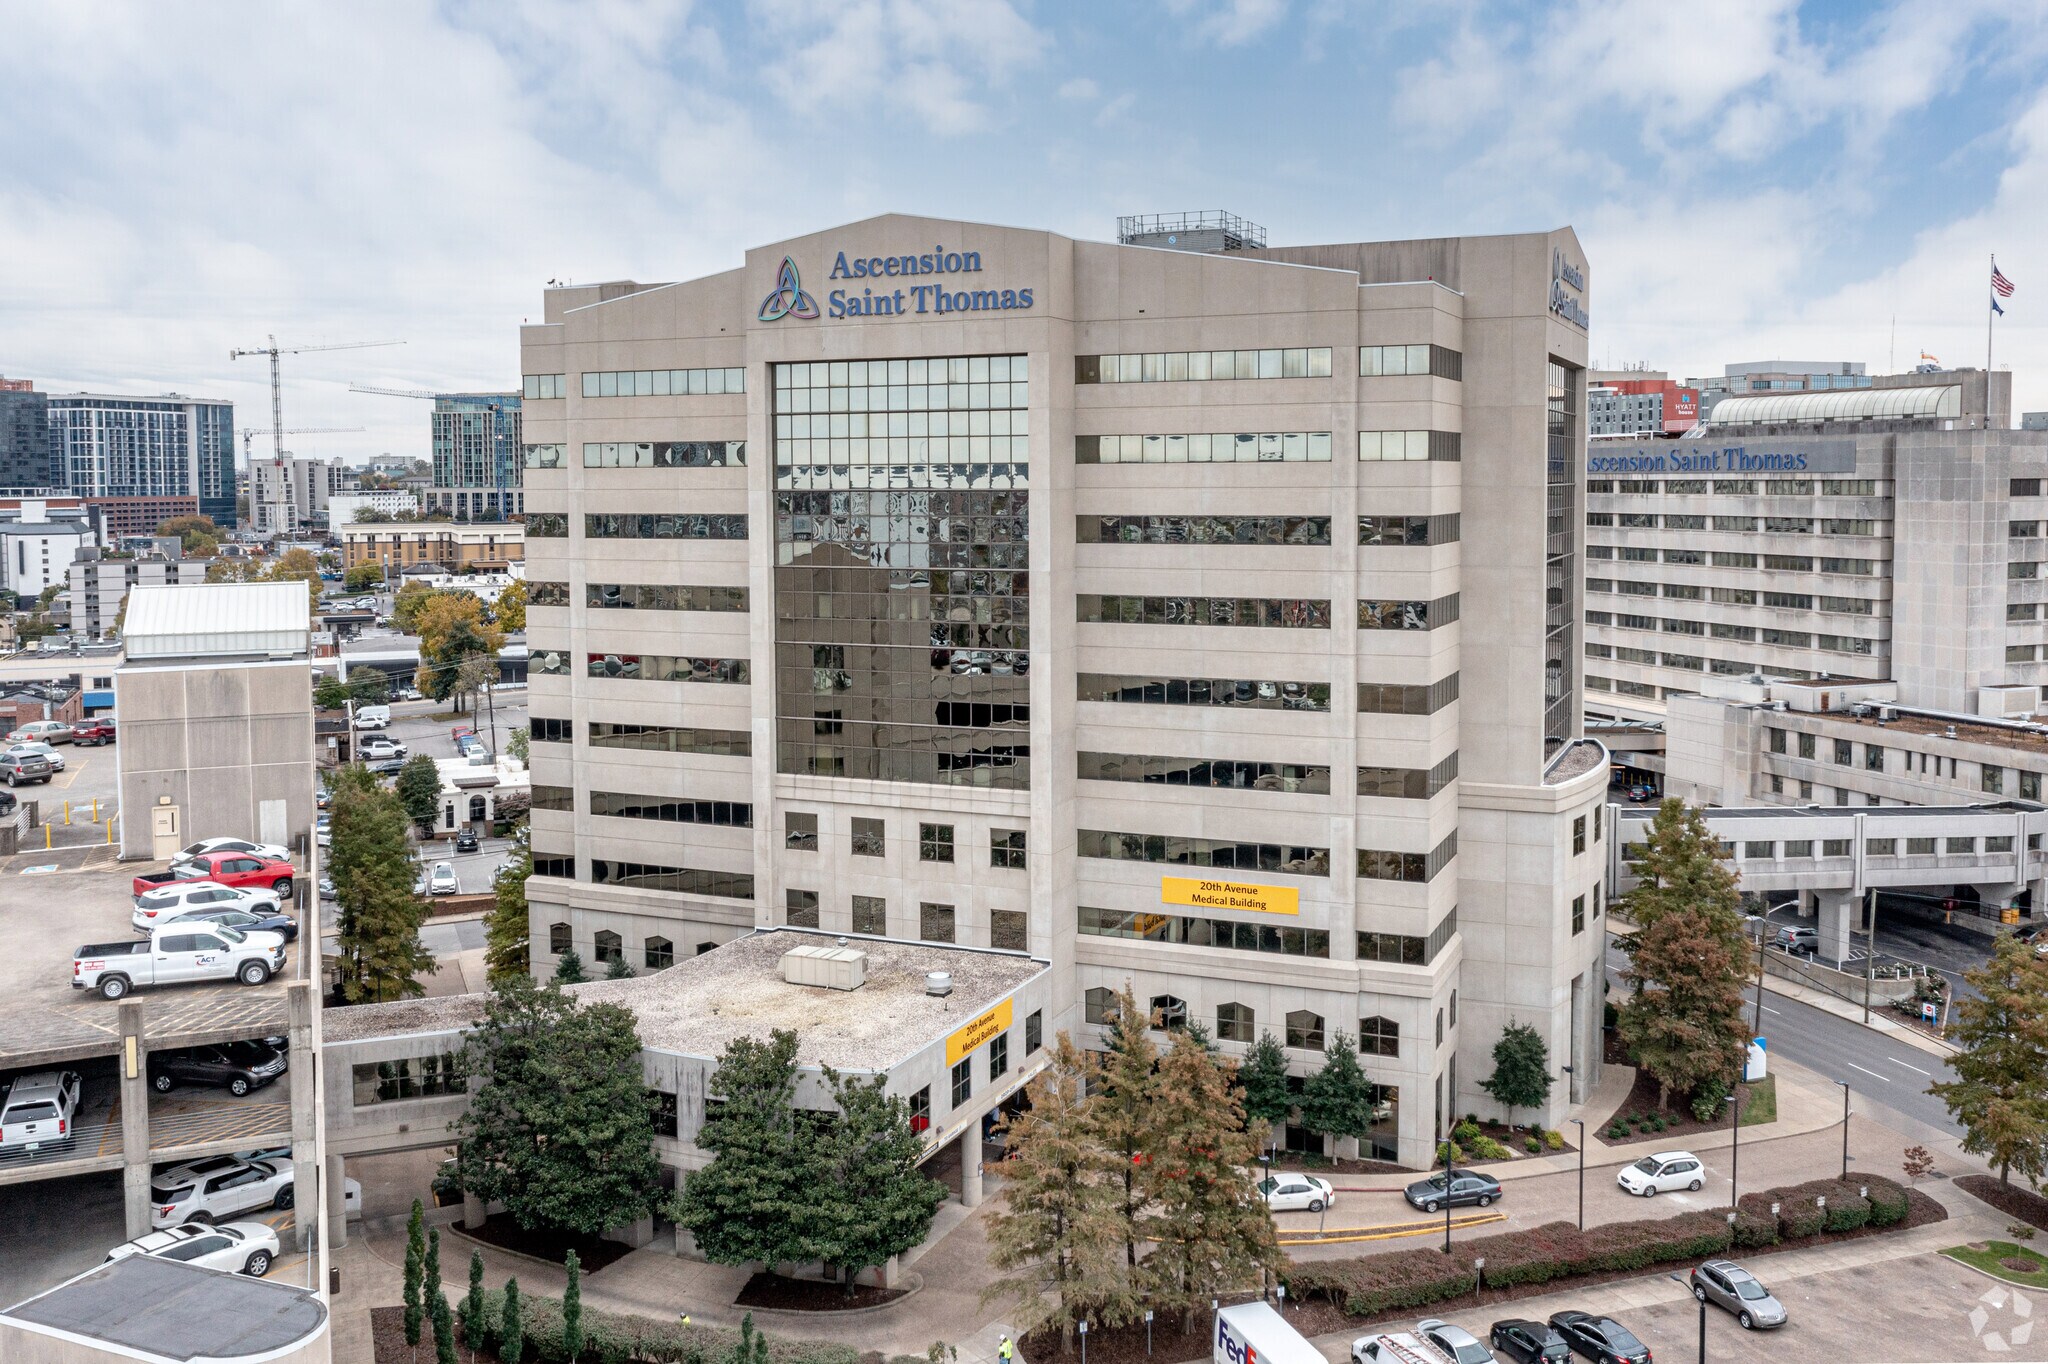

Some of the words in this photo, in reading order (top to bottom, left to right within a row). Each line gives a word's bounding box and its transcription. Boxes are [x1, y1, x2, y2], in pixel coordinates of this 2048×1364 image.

[829, 245, 983, 280] Ascension
[828, 287, 906, 318] Saint
[910, 283, 1034, 314] Thomas
[1587, 450, 1666, 472] scension
[1669, 449, 1721, 472] Saint
[1723, 447, 1808, 471] Thomas
[1200, 881, 1222, 892] 20th
[1224, 883, 1258, 895] Avenue
[1191, 894, 1228, 906] Medical
[1229, 897, 1267, 911] Building
[966, 1023, 978, 1037] 20th
[978, 1012, 995, 1028] Avenue
[962, 1033, 981, 1054] Medical
[981, 1024, 1000, 1041] Building
[1218, 1316, 1257, 1364] FedE
